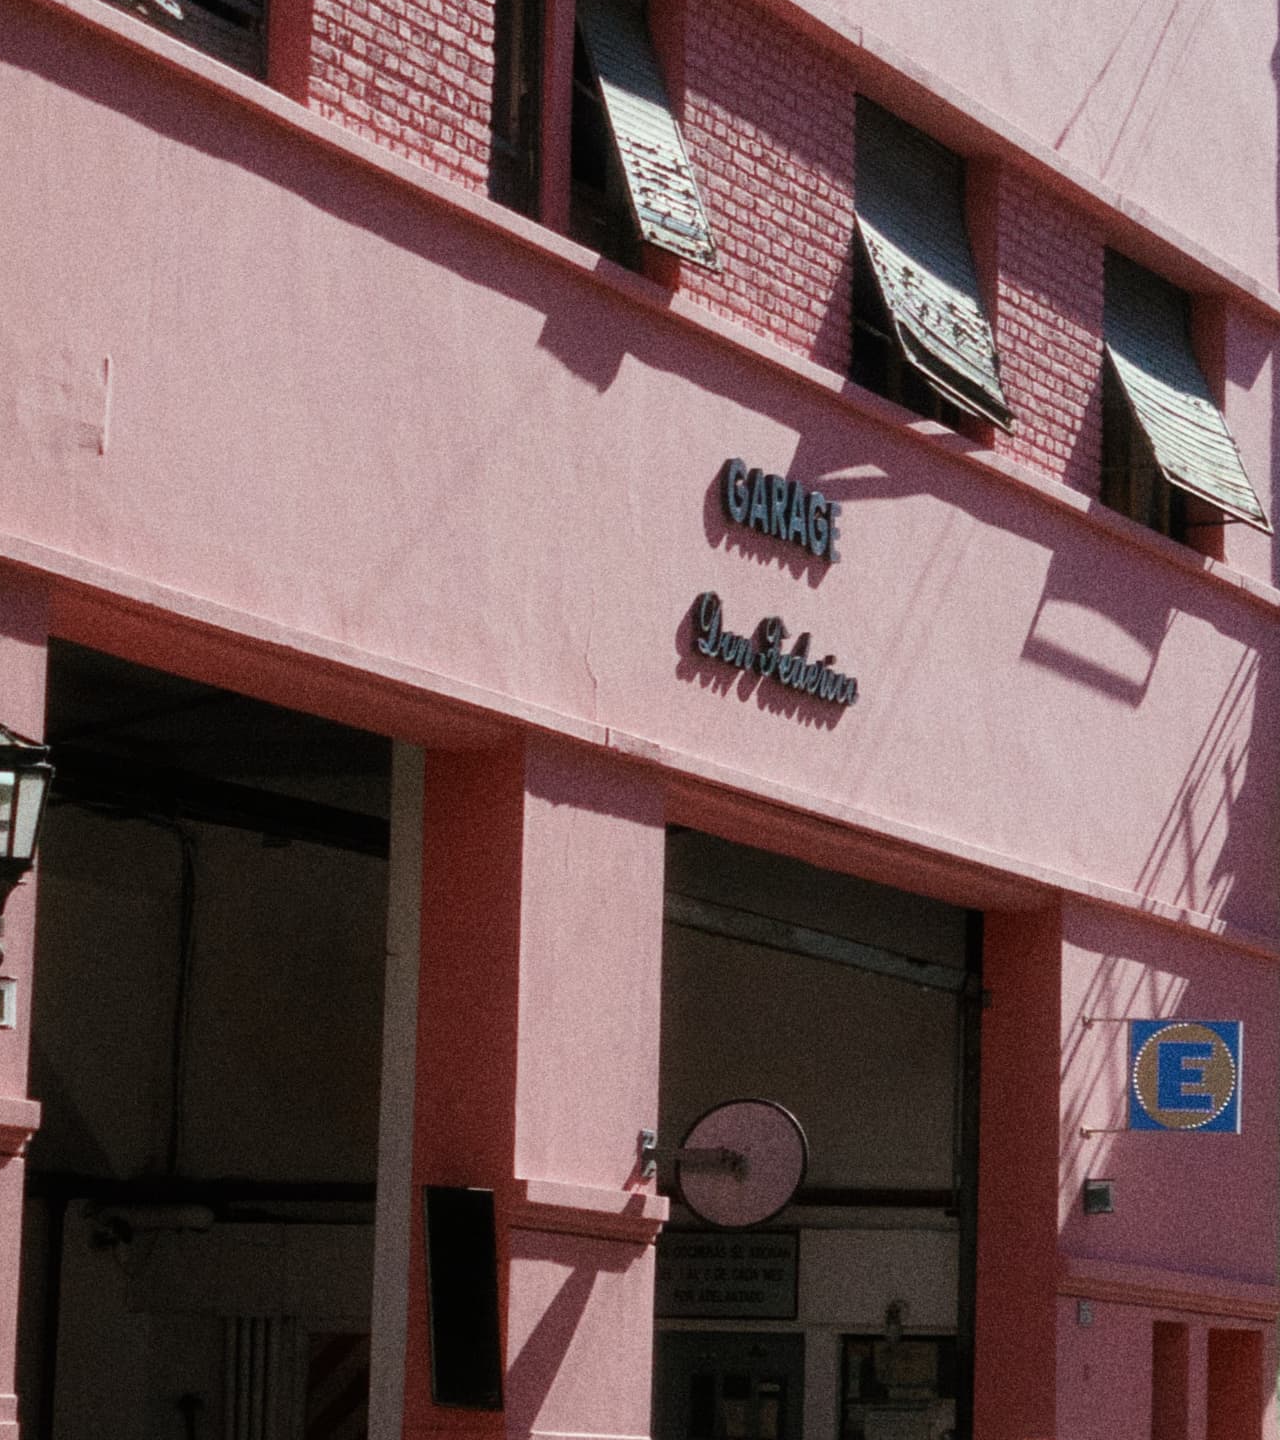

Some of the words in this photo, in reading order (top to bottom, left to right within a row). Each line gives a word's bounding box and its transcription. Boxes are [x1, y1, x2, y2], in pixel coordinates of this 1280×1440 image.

[723, 457, 842, 563] GARAGE
[697, 591, 754, 670] Don
[1158, 1042, 1214, 1112] E
